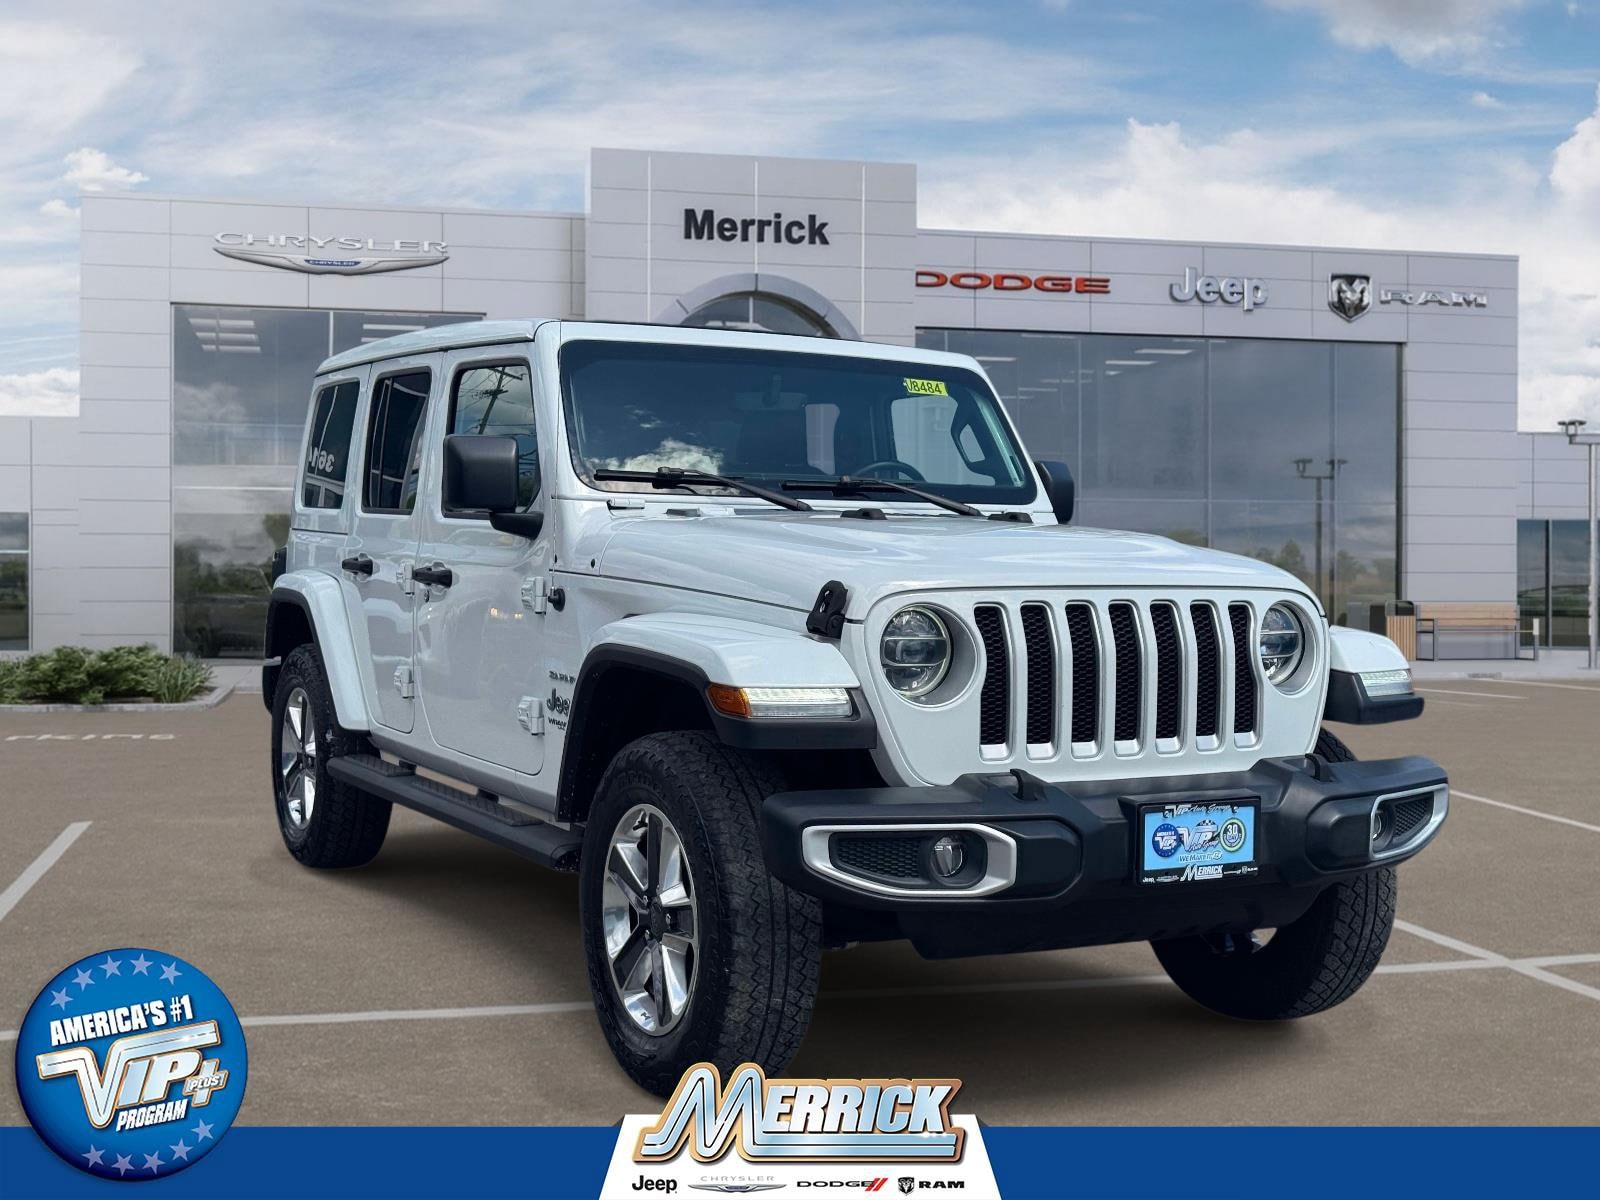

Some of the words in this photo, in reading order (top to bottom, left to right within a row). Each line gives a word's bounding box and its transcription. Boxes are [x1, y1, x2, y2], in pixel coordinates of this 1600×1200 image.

[684, 208, 830, 245] Merrick
[213, 230, 449, 254] CHRYSLER
[915, 270, 1111, 294] DODGE
[1169, 266, 1269, 311] Jeep
[1379, 289, 1488, 308] RAM
[546, 687, 571, 718] Jee
[1226, 824, 1238, 835] 30
[1180, 864, 1223, 881] MERRICK
